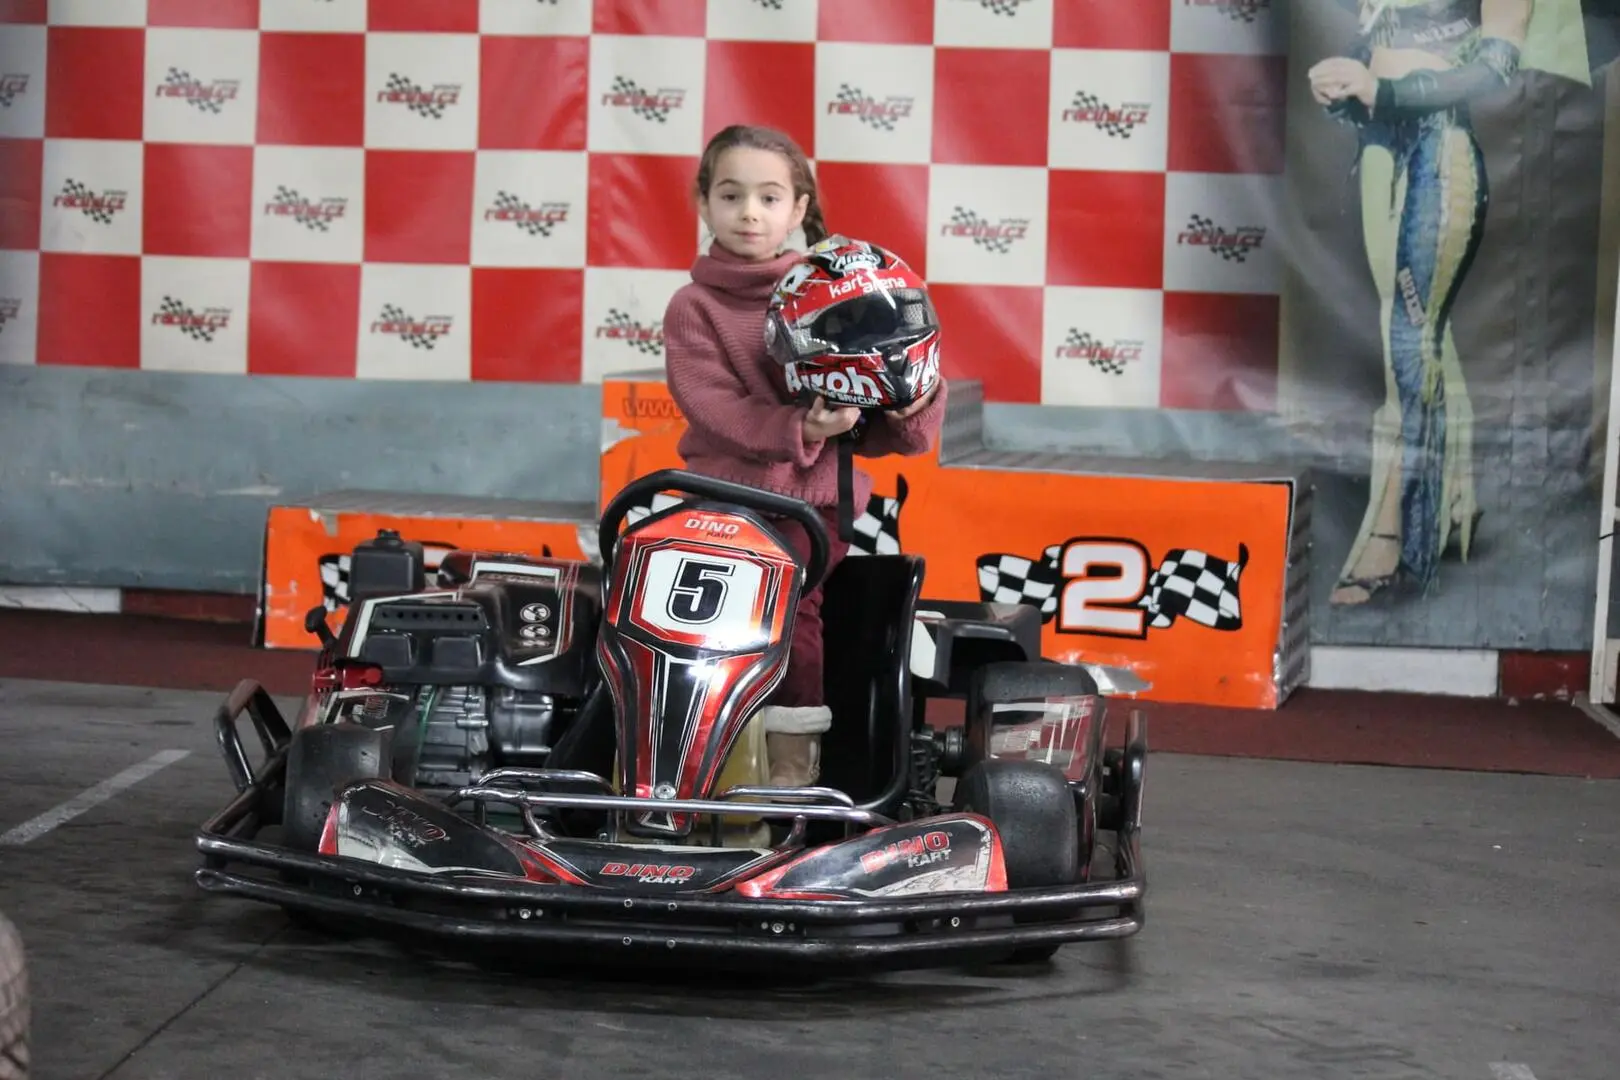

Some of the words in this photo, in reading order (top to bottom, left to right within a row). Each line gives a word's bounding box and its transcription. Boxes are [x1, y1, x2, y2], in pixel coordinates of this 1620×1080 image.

[829, 275, 863, 298] kart
[785, 362, 883, 399] Airoh
[684, 518, 740, 534] DINO
[706, 531, 737, 540] KART
[666, 557, 736, 625] 5
[1058, 537, 1149, 637] 2
[859, 831, 950, 873] DINO
[907, 848, 952, 868] KART
[599, 862, 696, 877] DINO
[638, 875, 690, 884] KART
